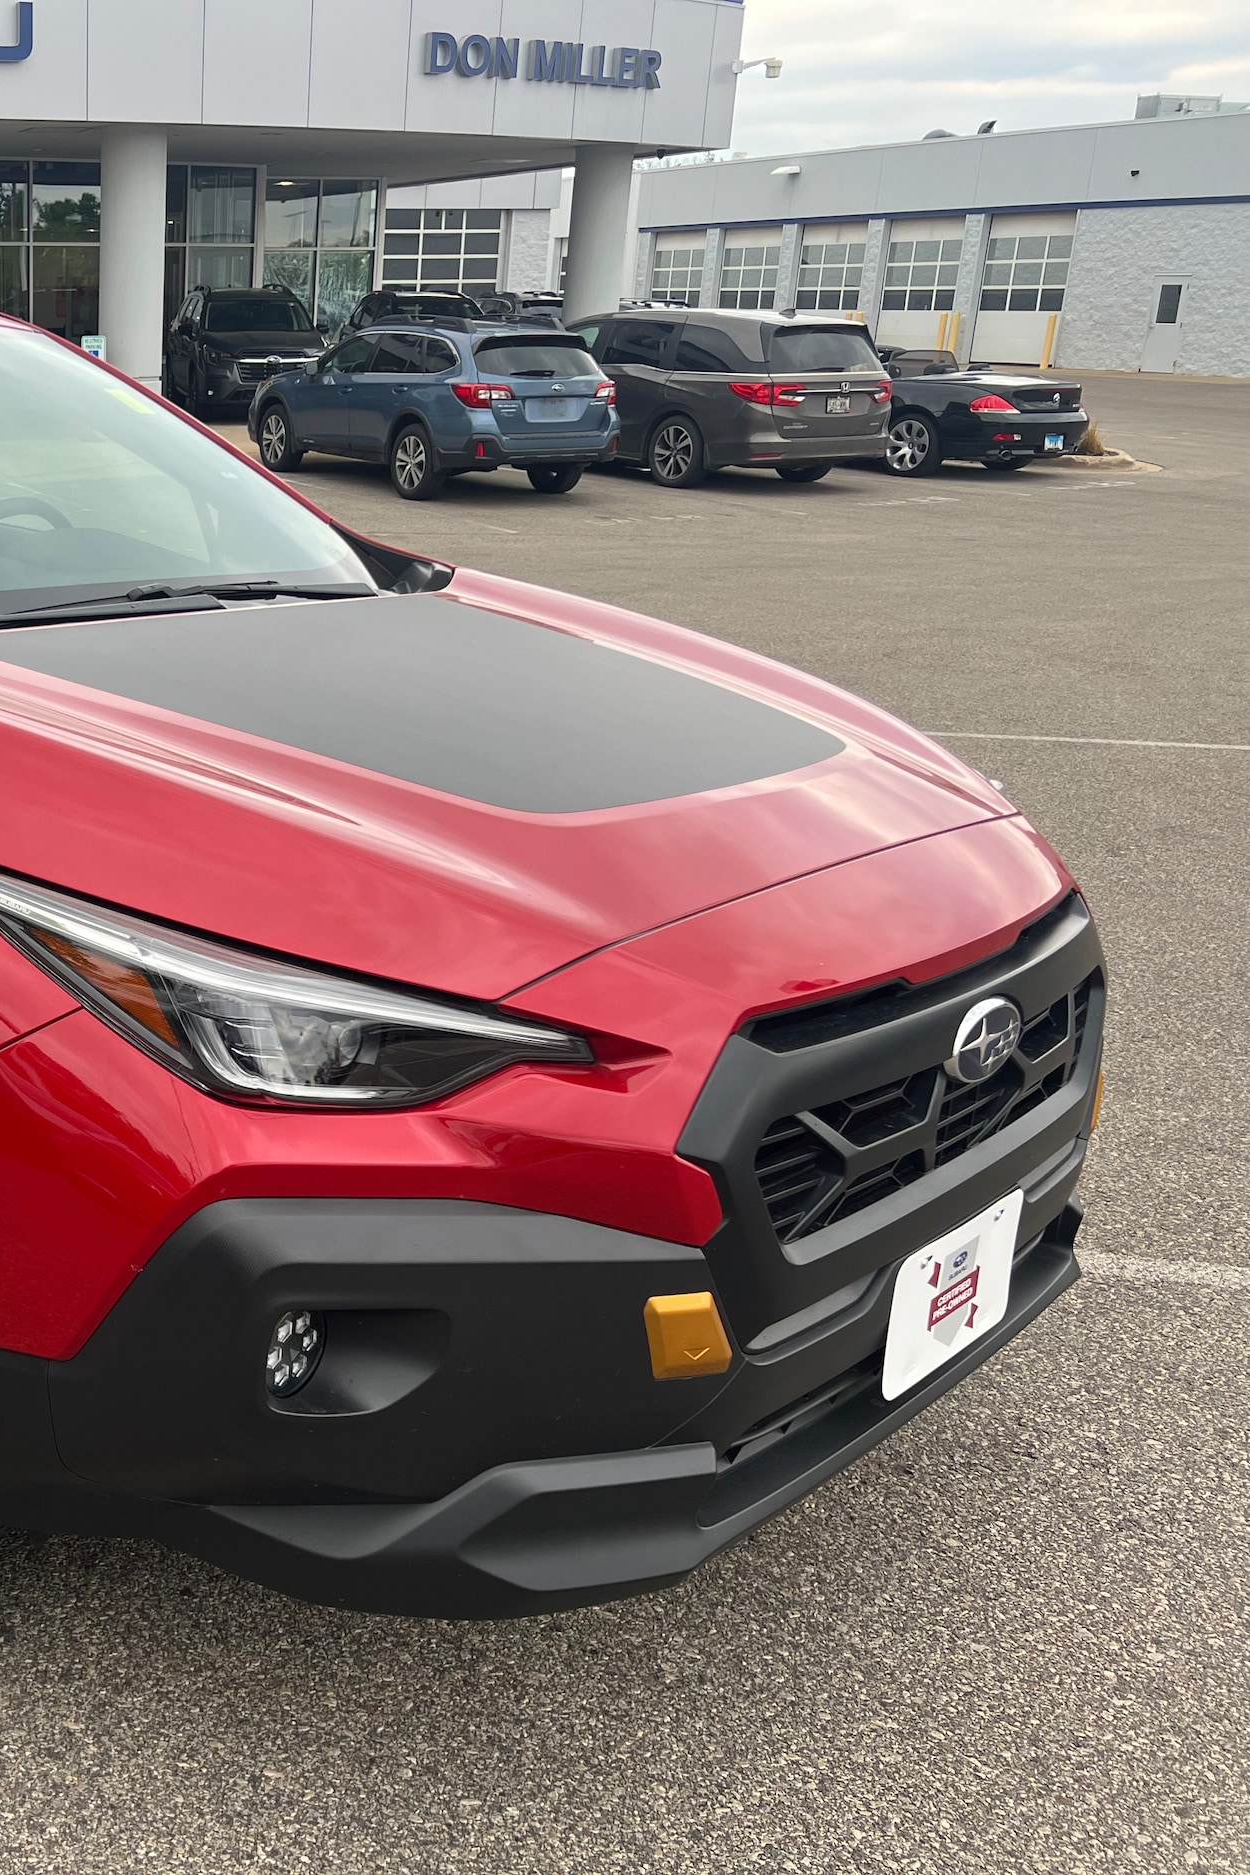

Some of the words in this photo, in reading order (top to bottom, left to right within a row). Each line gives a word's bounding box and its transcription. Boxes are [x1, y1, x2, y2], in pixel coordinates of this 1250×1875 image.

[424, 31, 520, 79] DON
[527, 39, 662, 89] MILLER
[932, 1286, 973, 1321] PRE-OWNED
[937, 1277, 972, 1307] CERTIFIED
